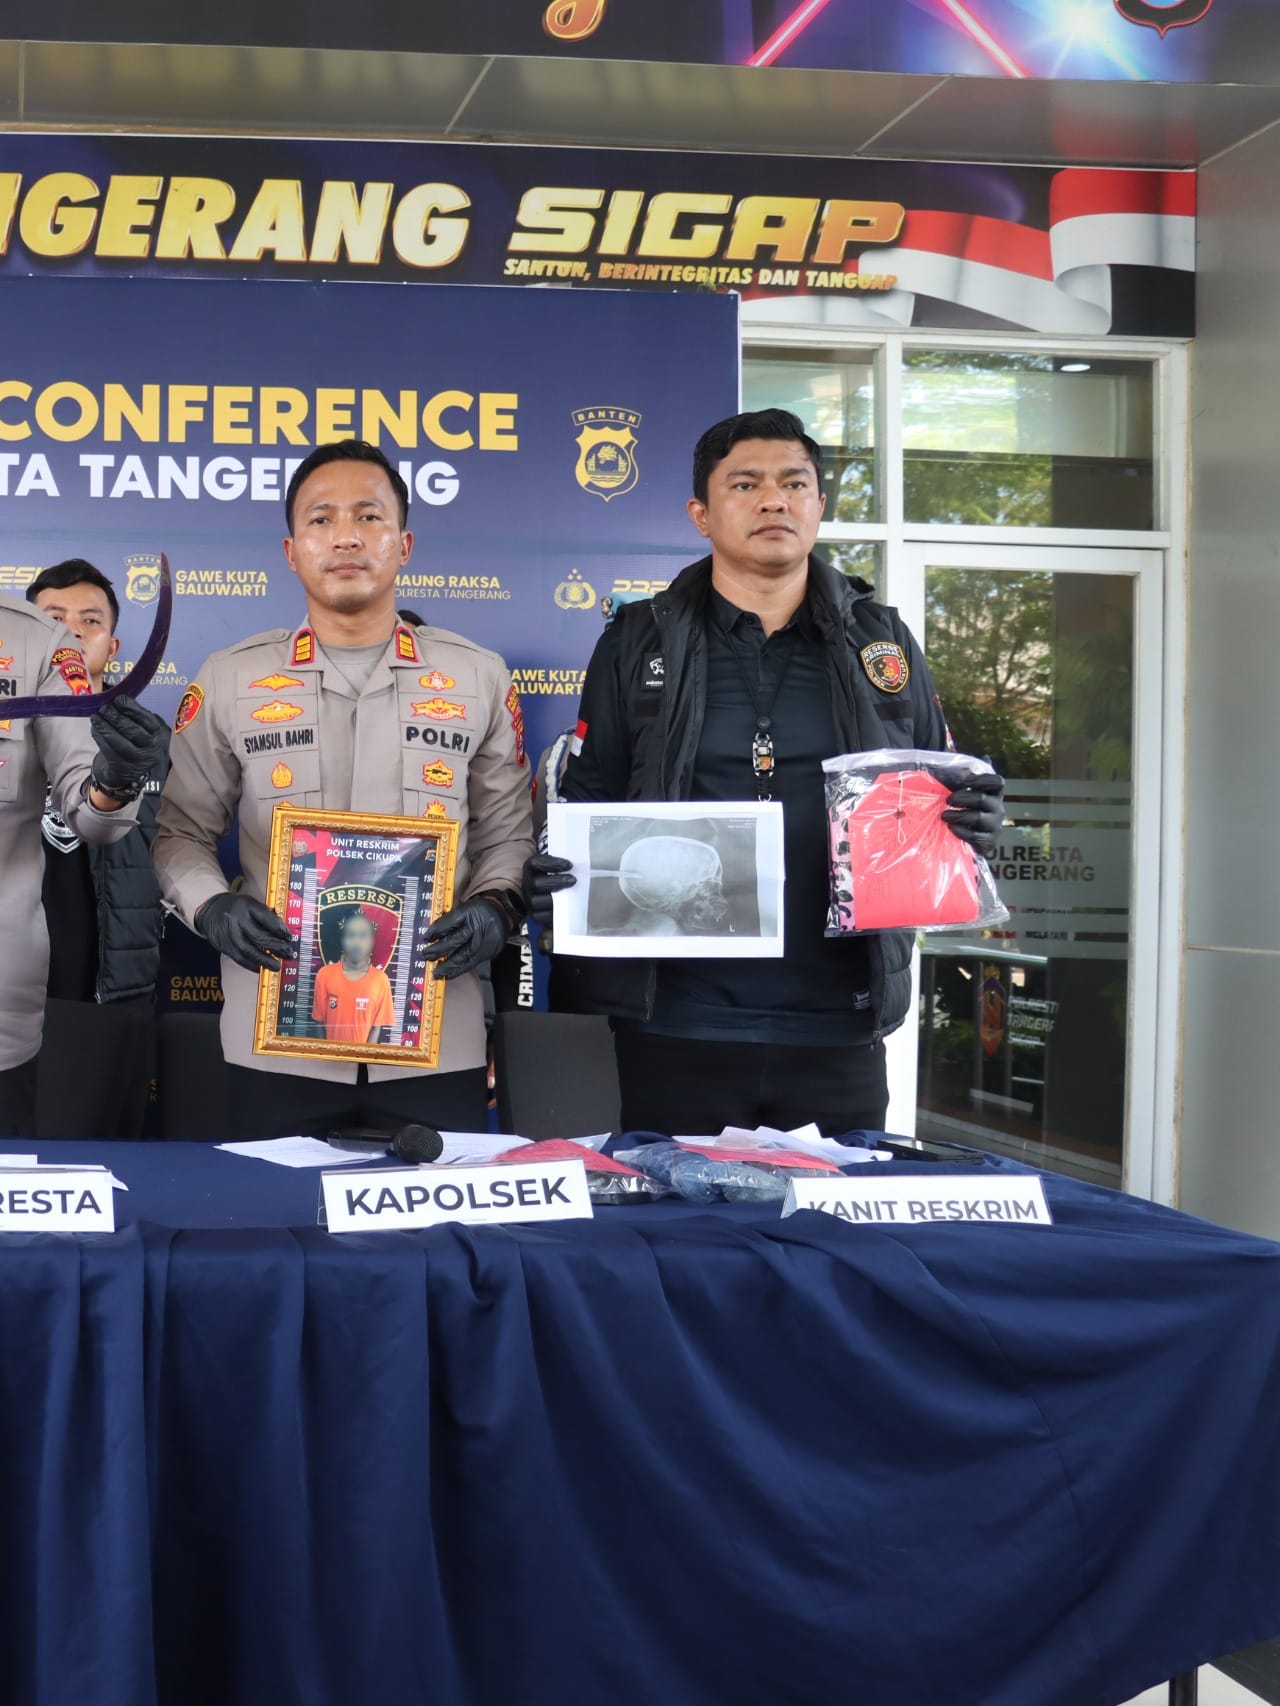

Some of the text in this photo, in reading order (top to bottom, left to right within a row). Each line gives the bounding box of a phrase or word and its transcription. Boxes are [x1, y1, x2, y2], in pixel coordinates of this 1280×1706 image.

[506, 186, 905, 265] SIGAP
[504, 257, 898, 291] SANTUN, BERINTEGRITAS DAN TANGGAP
[577, 410, 637, 424] BANTEN
[80, 453, 460, 506] TANGEG
[175, 569, 268, 584] GAWE KUTA
[448, 575, 500, 589] RAKSA
[175, 582, 267, 597] BALUWARTI
[394, 588, 511, 600] OLRESTA TANGERANG
[511, 668, 546, 682] AWE
[244, 728, 314, 754] SYAMSUL BAHRI
[405, 726, 470, 754] POLRI
[331, 837, 400, 851] UNIT RESKRIM
[326, 848, 402, 863] POLSEK CIKUPA
[984, 845, 1083, 863] OLRESTA
[290, 864, 303, 873] 190
[289, 881, 302, 890] 180
[288, 899, 301, 908] 170
[326, 888, 397, 909] RESERSE
[287, 917, 300, 925] 160
[285, 968, 297, 976] 130
[170, 975, 218, 989] GAWE
[284, 984, 296, 992] 120
[412, 977, 424, 985] 130
[410, 993, 422, 1001] 120
[282, 1016, 294, 1024] 100
[408, 1009, 420, 1017] 110
[407, 1025, 419, 1033] 100
[345, 1176, 572, 1217] KAPOLSEK
[908, 1199, 1040, 1221] RESKRIM
